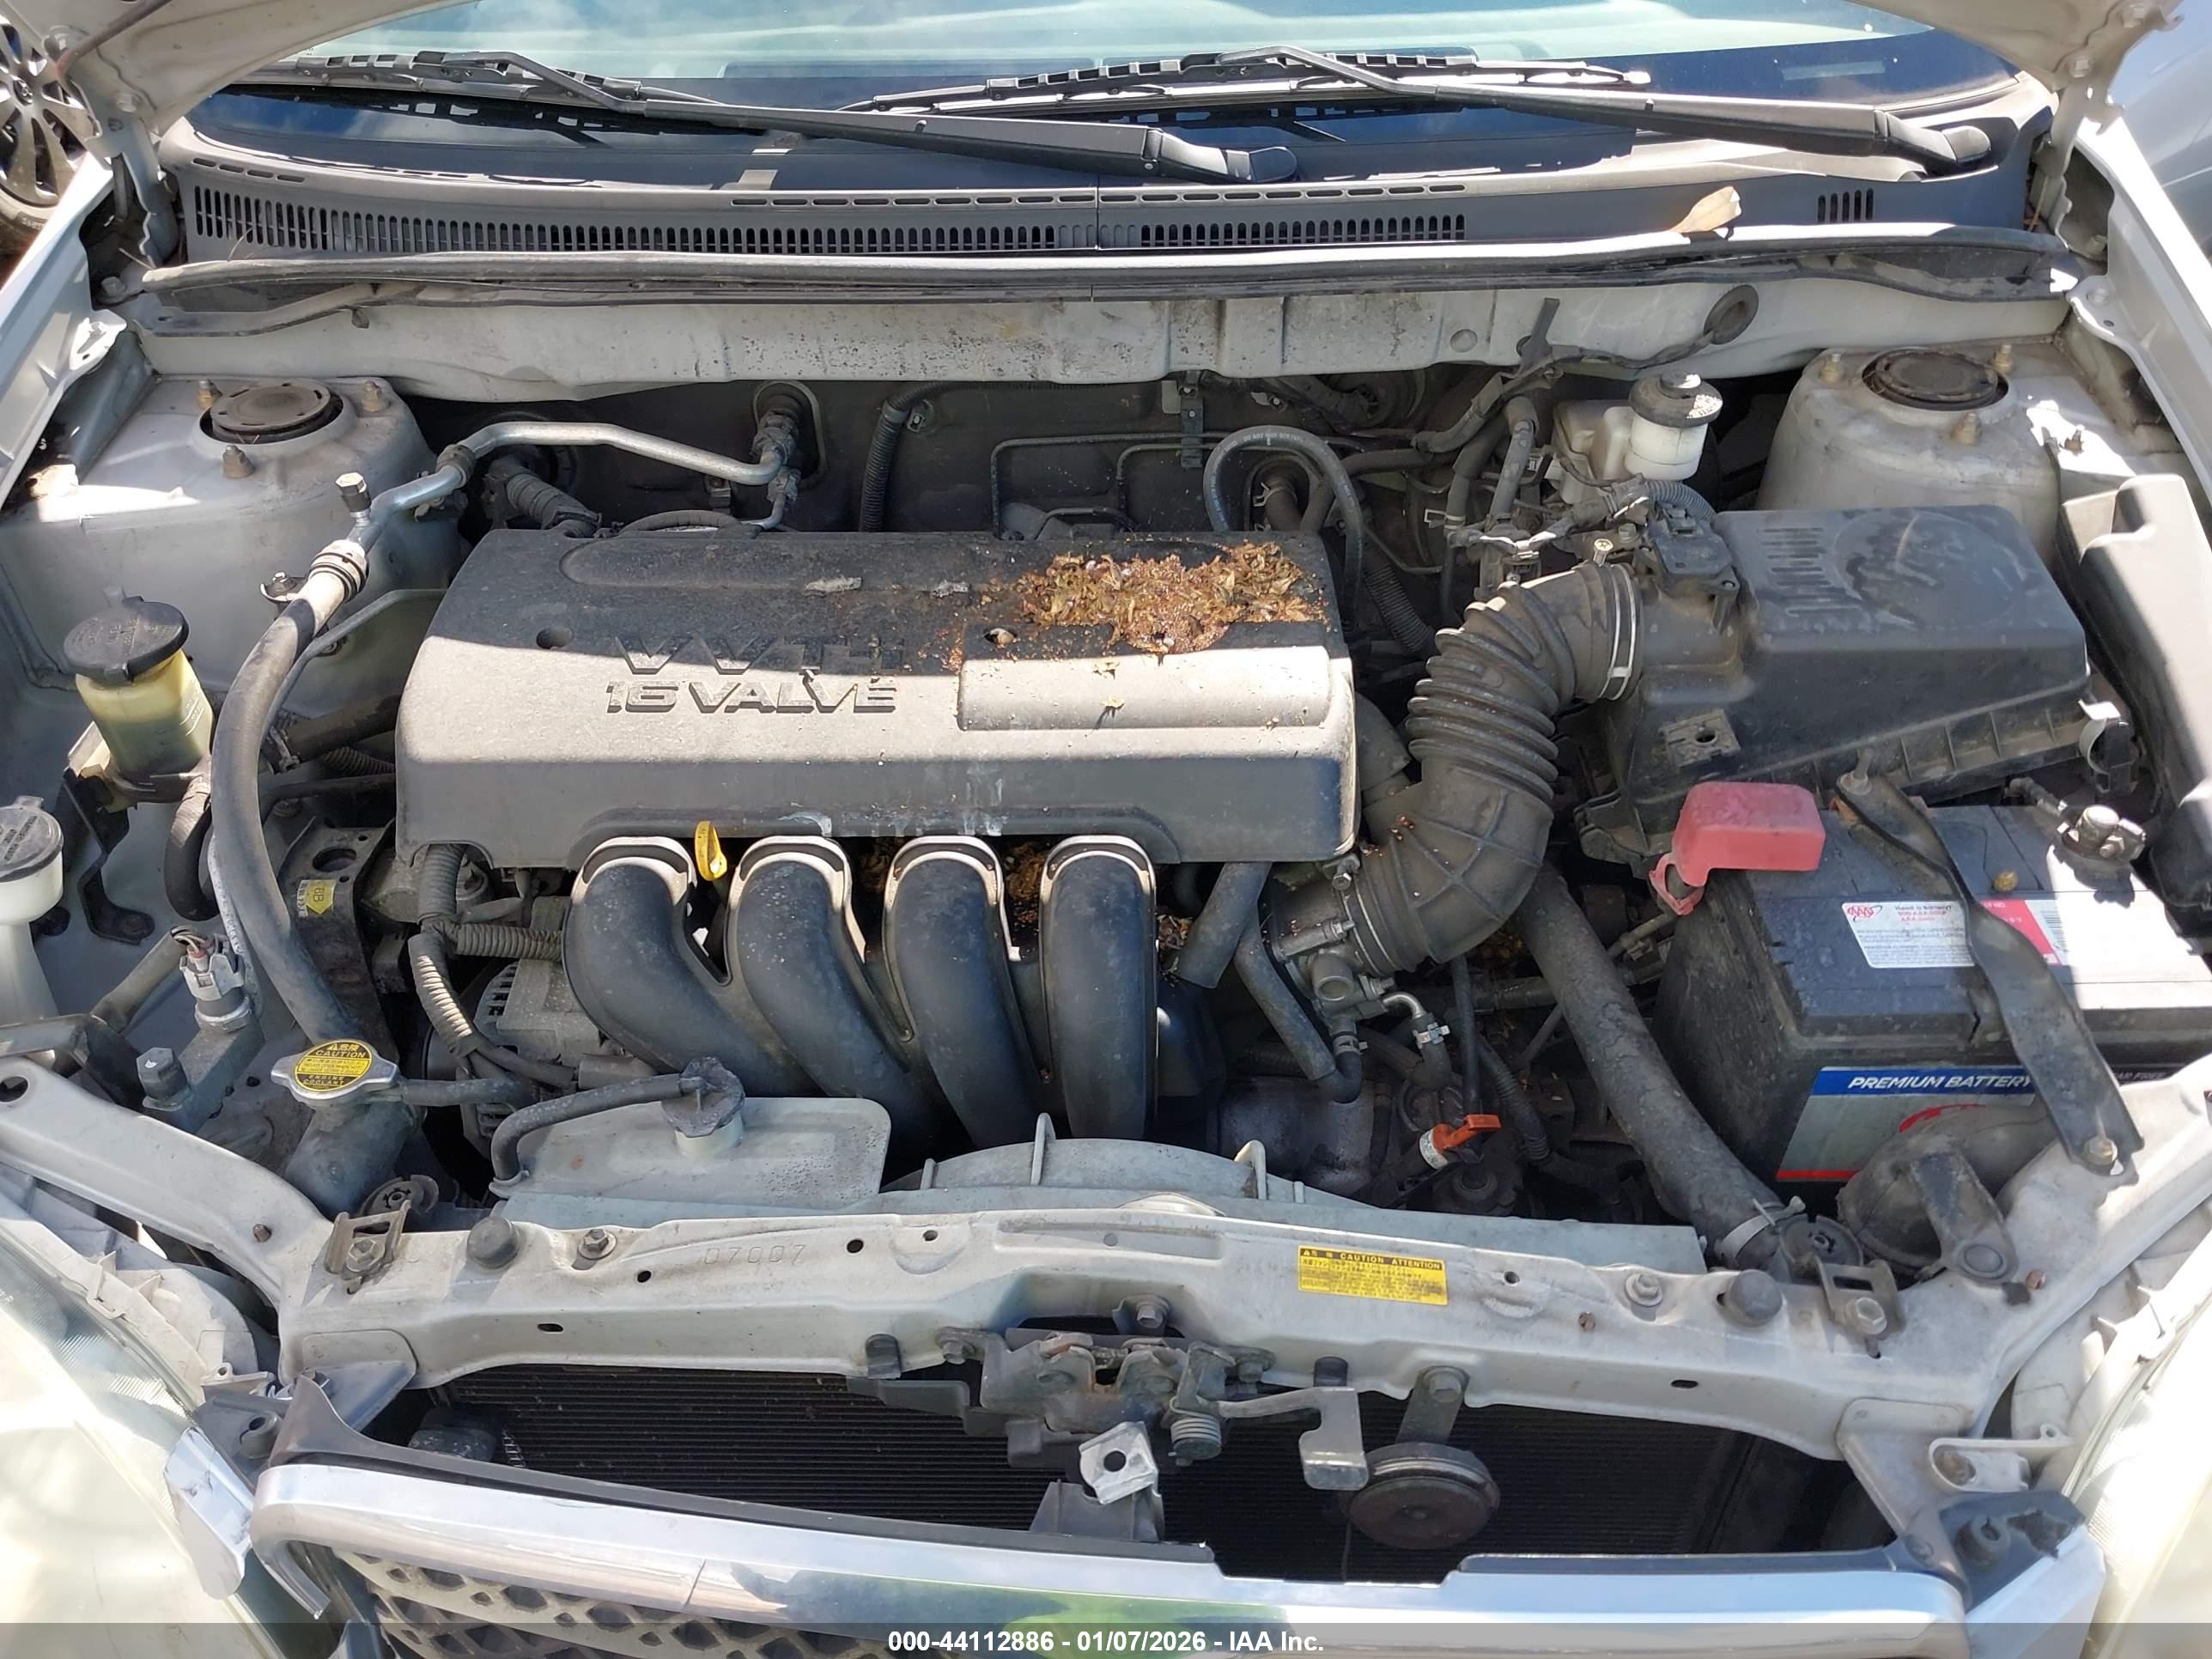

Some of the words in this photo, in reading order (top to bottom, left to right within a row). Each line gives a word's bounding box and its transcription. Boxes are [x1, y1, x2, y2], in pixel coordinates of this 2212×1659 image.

[605, 681, 679, 714] 16
[688, 681, 897, 714] VALVE
[1847, 1076, 1943, 1089] PREMIUM
[1340, 1251, 1384, 1263] CAUTION
[1392, 1258, 1440, 1269] ATTENTION
